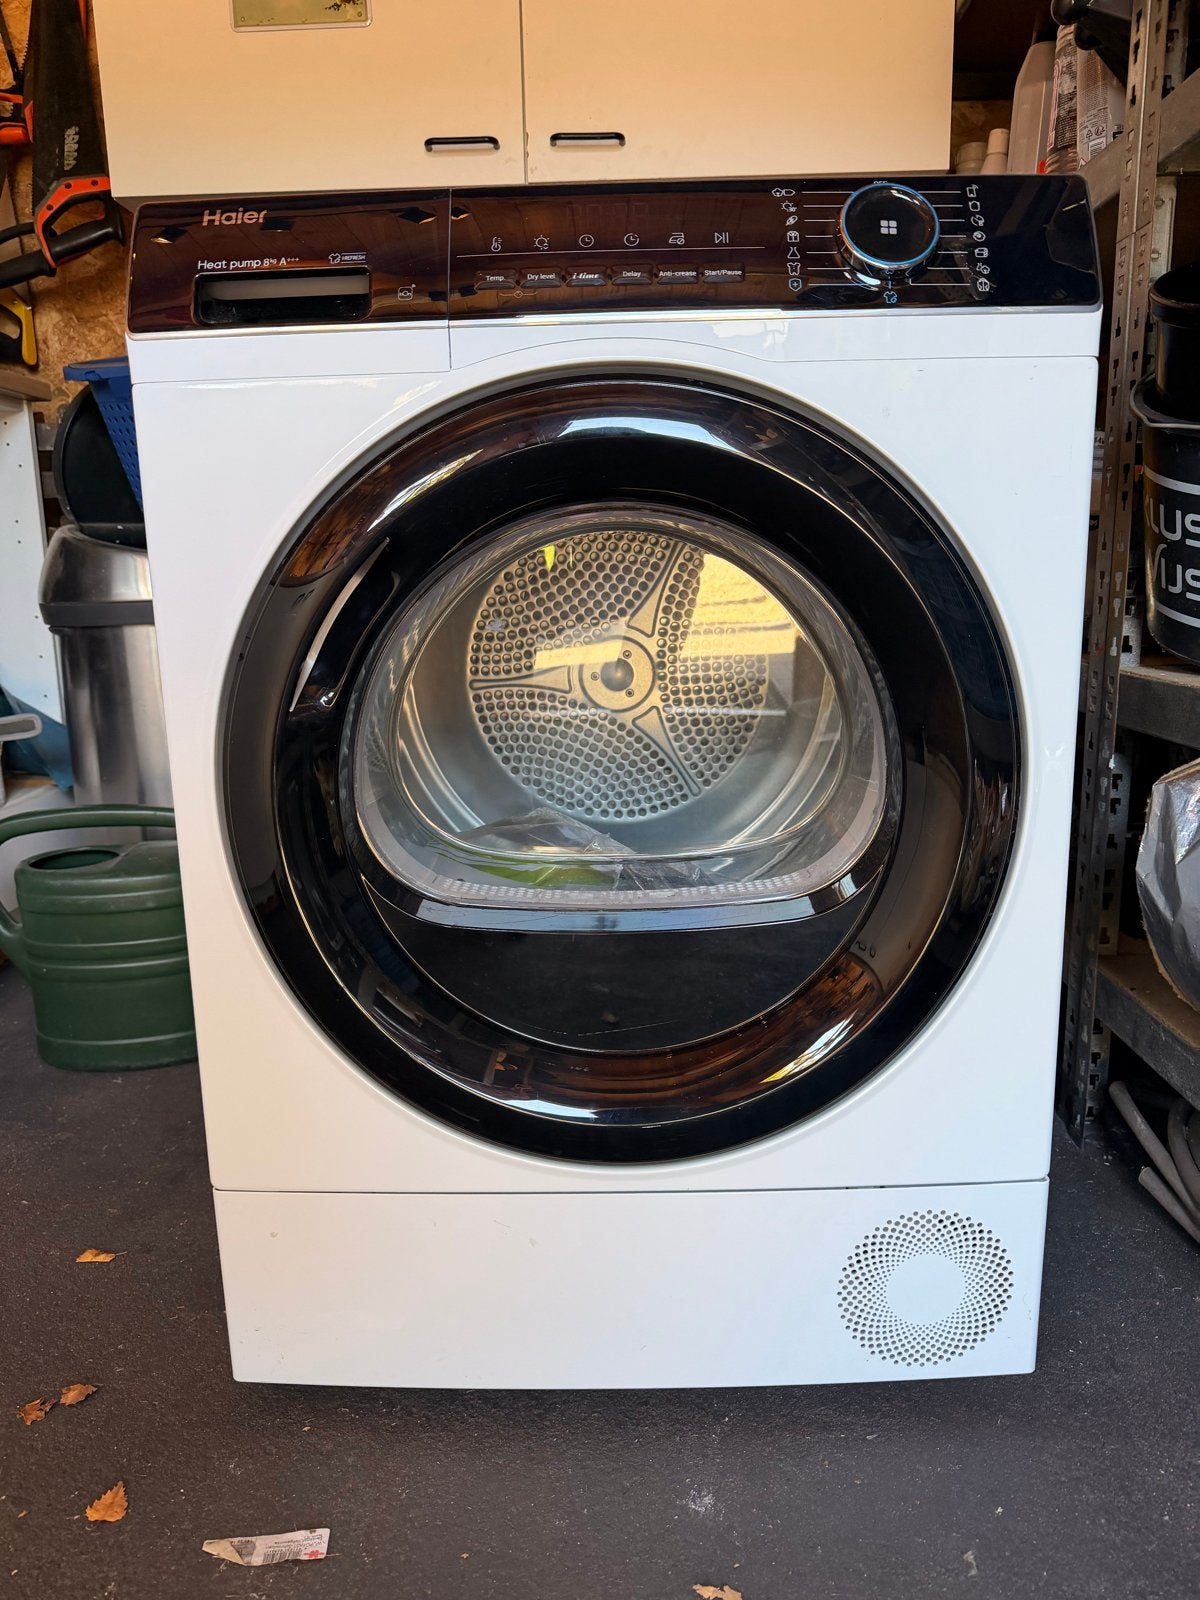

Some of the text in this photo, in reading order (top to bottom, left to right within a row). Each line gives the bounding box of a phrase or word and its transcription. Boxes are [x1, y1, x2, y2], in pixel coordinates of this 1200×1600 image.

[202, 207, 268, 226] Haier
[197, 259, 227, 270] Heat
[229, 259, 261, 271] pump
[527, 273, 540, 281] Dry
[572, 272, 600, 280] i-time
[622, 270, 642, 278] Delay
[659, 269, 697, 277] Anti-crease
